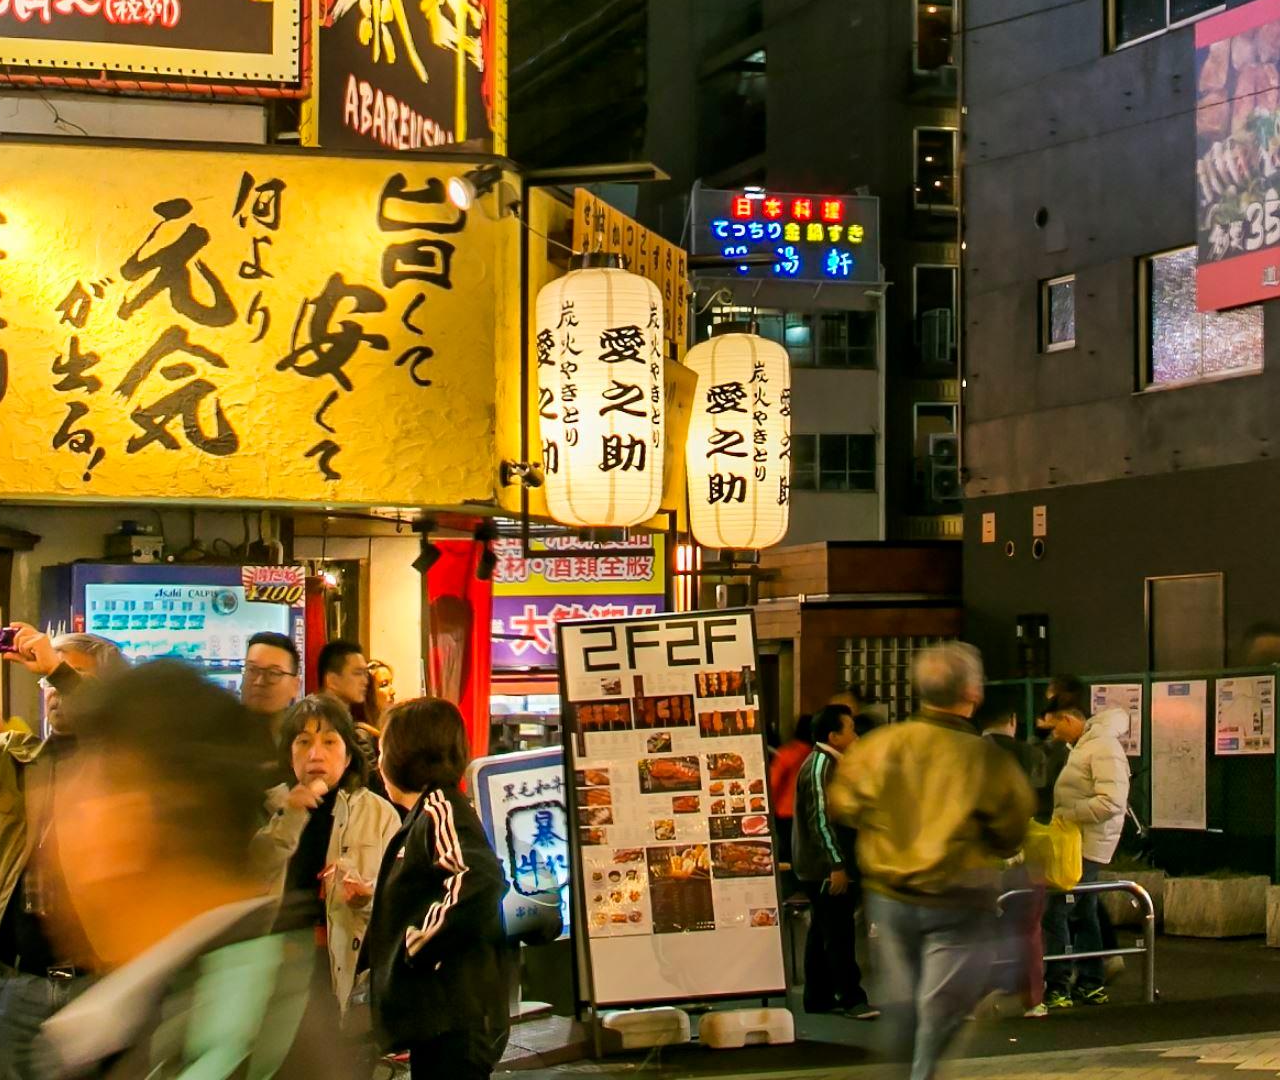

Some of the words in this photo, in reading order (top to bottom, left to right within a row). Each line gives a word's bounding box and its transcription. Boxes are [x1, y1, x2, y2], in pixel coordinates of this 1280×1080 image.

[231, 170, 287, 344] 何より
[712, 220, 782, 239] てっちり
[724, 245, 853, 276] 湯軒
[735, 197, 841, 221] 日本料理
[111, 197, 239, 456] 元気
[377, 172, 467, 387] 旨くて
[275, 272, 390, 482] 安くて
[556, 300, 584, 447] 炭火やきとり
[598, 324, 648, 473] 愛之助
[748, 360, 771, 482] 炭火やきとり
[705, 381, 749, 505] 愛之助
[154, 588, 182, 598] Asahi
[248, 585, 303, 601] ¥100
[493, 554, 653, 581] 材・酒類全般
[580, 619, 737, 672] 2F2F
